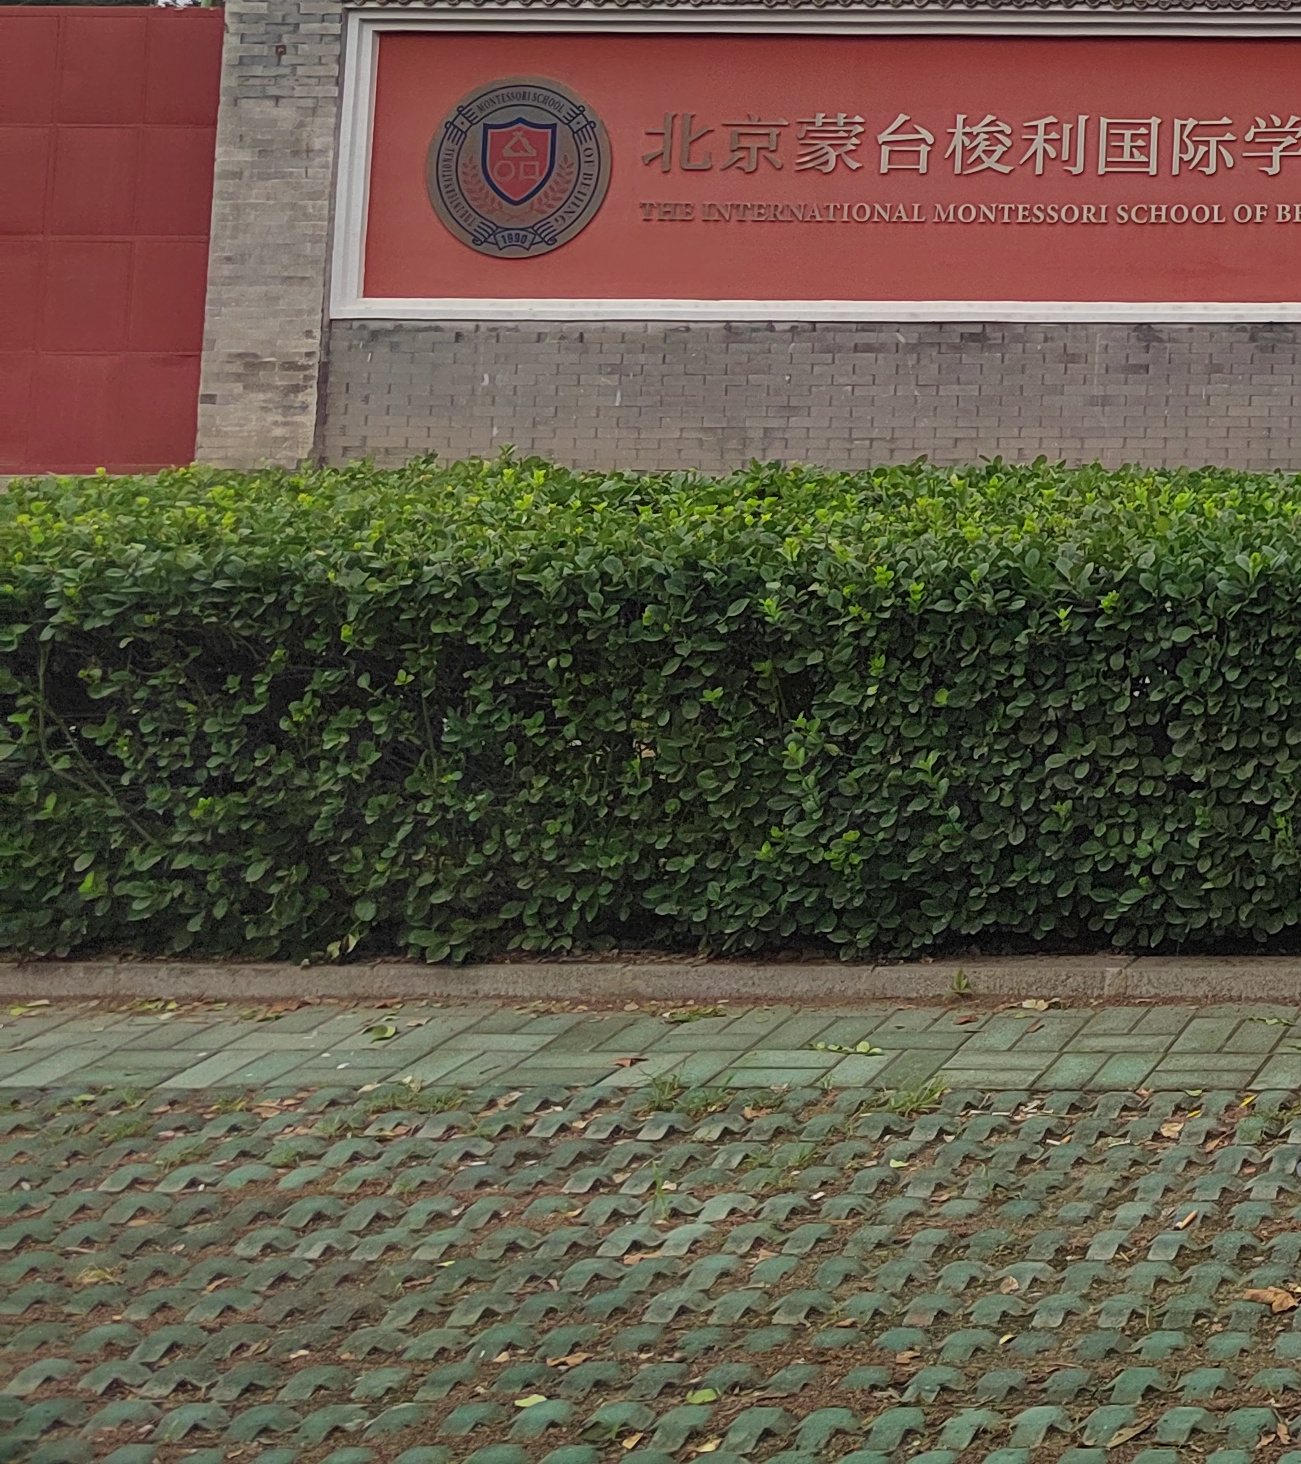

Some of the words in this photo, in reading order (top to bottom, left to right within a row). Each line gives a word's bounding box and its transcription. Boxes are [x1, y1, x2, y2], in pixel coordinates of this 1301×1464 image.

[477, 91, 531, 114] MONTESSORI
[532, 92, 565, 114] SCHOOL
[583, 147, 595, 168] OF
[554, 172, 594, 228] BEIJING
[639, 201, 695, 222] THE
[702, 202, 926, 224] INTERNATIONAL
[933, 203, 1108, 224] MONTESSORI
[1116, 203, 1226, 224] SCHOOL
[1233, 203, 1269, 224] OF
[500, 233, 529, 245] 1990
